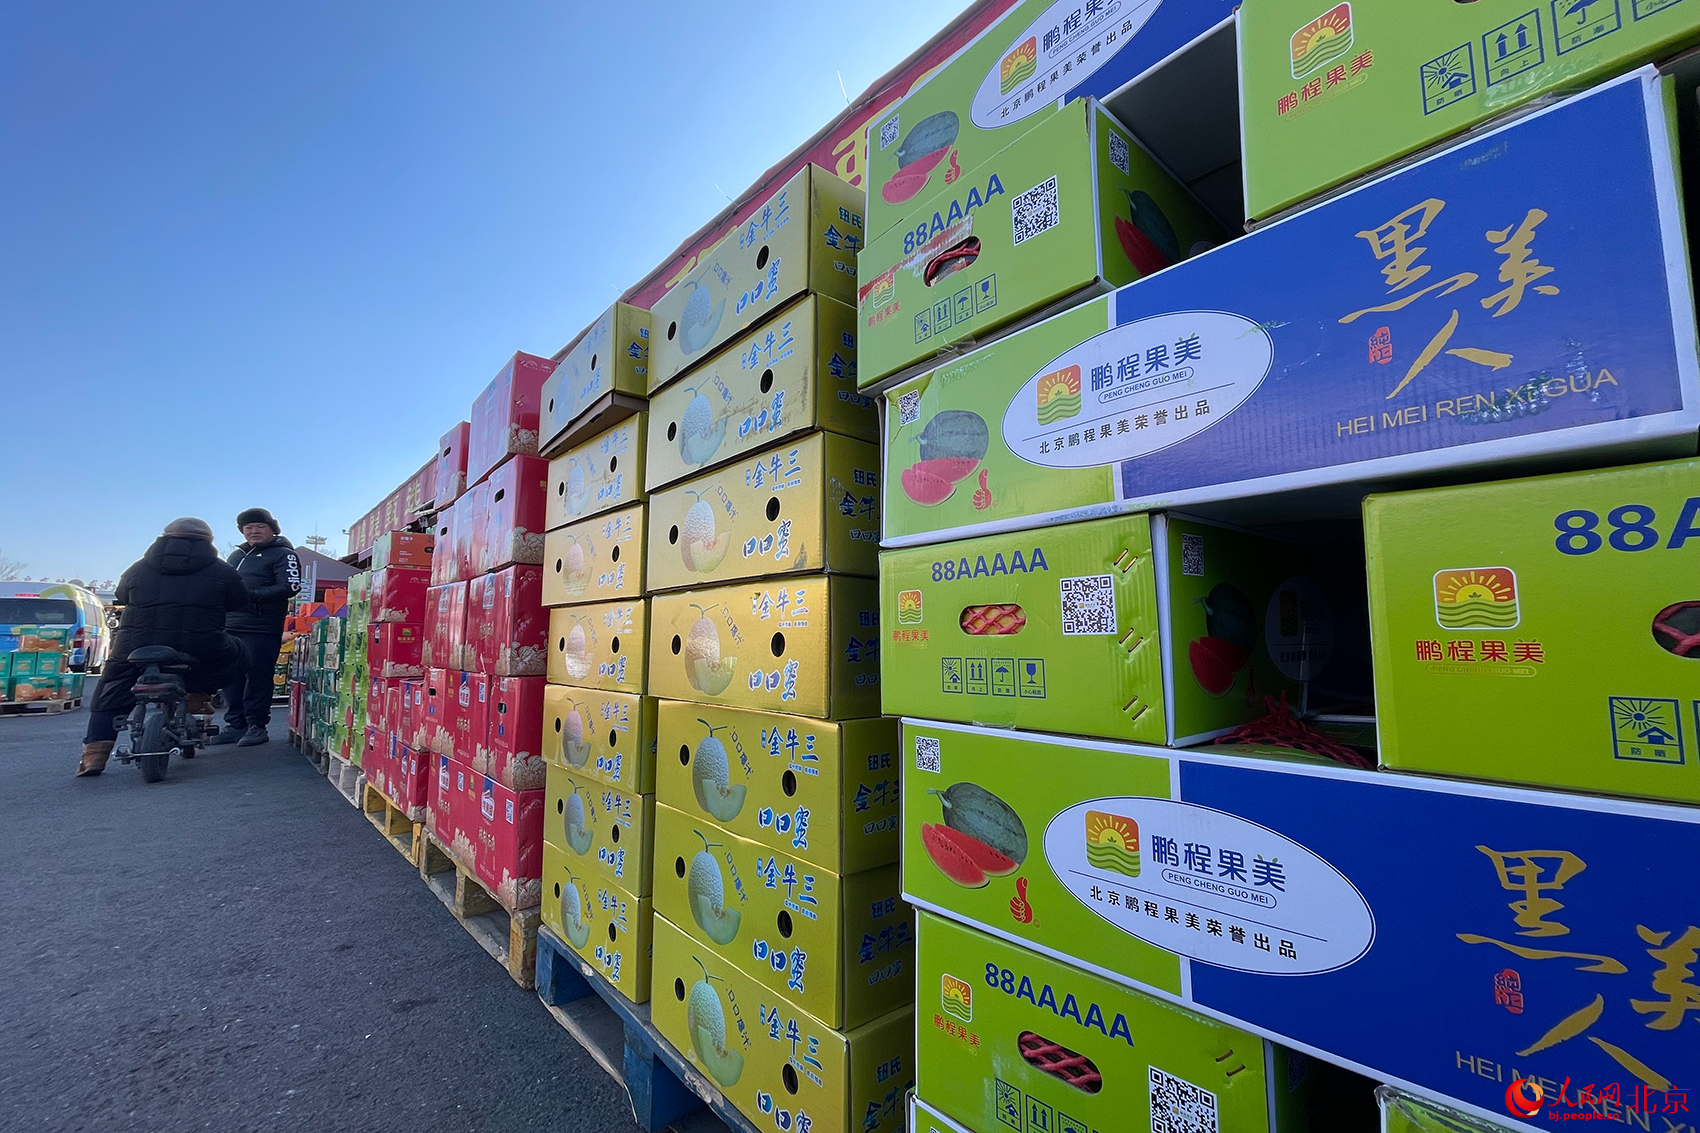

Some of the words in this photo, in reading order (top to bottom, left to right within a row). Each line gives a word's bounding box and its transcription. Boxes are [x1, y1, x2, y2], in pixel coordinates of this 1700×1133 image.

[1043, 0, 1114, 53] 鹏程果
[1000, 19, 1133, 119] 北京鹏程果美荣誉出品
[1277, 49, 1374, 116] 鹏程果美
[746, 191, 790, 248] 金牛三
[903, 173, 1005, 255] 88AAAA
[867, 301, 900, 328] 鹏程果美
[748, 322, 794, 371] 金牛三
[1091, 332, 1201, 391] 鹏程果美
[1103, 387, 1124, 401] PENG
[1124, 381, 1151, 396] CHENG
[1152, 375, 1171, 388] GUO
[1172, 370, 1188, 382] MEI
[1337, 415, 1375, 437] HEI
[1382, 405, 1427, 430] MEI
[1436, 391, 1496, 419] REN
[1543, 368, 1619, 398] GUA
[1039, 399, 1211, 455] 北京鹏程果美荣誉出品
[752, 449, 801, 490] 金牛三
[839, 491, 880, 521] 金牛
[742, 519, 792, 561] 口口蜜
[931, 547, 1049, 583] 88AAAAA
[759, 588, 809, 621] 金牛三
[893, 629, 930, 642] 鹏程果美
[1415, 638, 1545, 664] 鹏程果美
[748, 659, 799, 702] 口口蜜
[767, 725, 819, 762] 金牛三
[867, 752, 891, 771] 钮氏
[757, 805, 811, 851] 口口蜜
[763, 856, 818, 906] 金牛三
[1152, 834, 1286, 892] 鹏程果美
[1168, 873, 1192, 885] PENG
[1194, 879, 1225, 893] CHENG
[1227, 887, 1249, 899] GUO
[1251, 892, 1269, 904] MEI
[856, 922, 913, 965] 金牛三
[1090, 886, 1297, 960] 北京鹏程果美荣誉出品
[753, 938, 807, 994] 口口蜜
[984, 962, 1135, 1048] 88AAAAA
[766, 1005, 823, 1071] 金牛三
[934, 1013, 980, 1049] 鹏程果美
[1456, 1051, 1502, 1082] HEI
